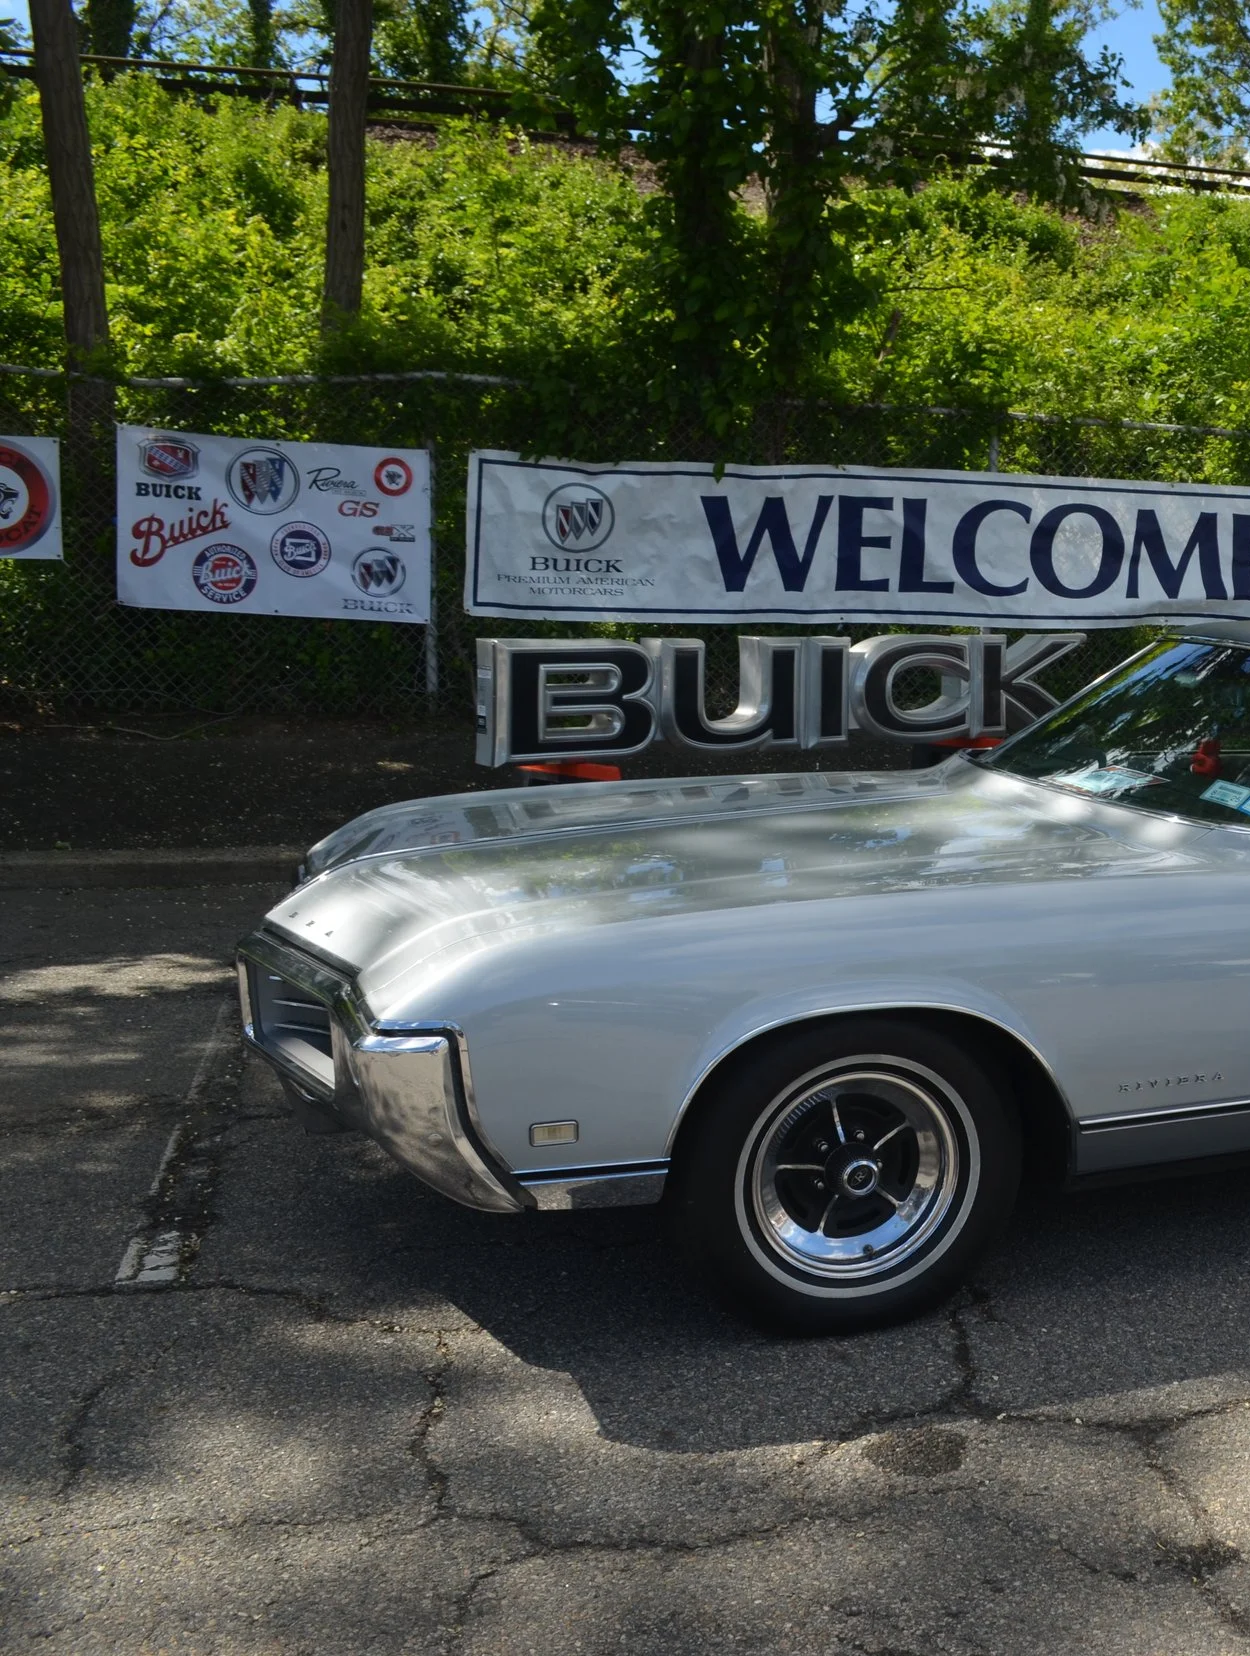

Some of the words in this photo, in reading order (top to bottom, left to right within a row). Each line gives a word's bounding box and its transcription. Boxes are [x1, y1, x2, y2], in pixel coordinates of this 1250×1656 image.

[306, 467, 360, 492] Riviera
[136, 482, 202, 501] BUICK
[338, 499, 380, 518] GS
[130, 498, 233, 567] Buick
[204, 544, 247, 561] AUTHORIZED
[199, 560, 254, 585] Buick
[529, 556, 624, 573] BUICK
[497, 573, 570, 585] PREMIUM
[575, 575, 655, 587] AMERICAN
[201, 585, 248, 604] SERVICE
[529, 586, 625, 597] MOTORCARS
[342, 598, 415, 614] BUICK
[476, 634, 1088, 767] BUICK
[1118, 1071, 1225, 1093] RIVIERA
